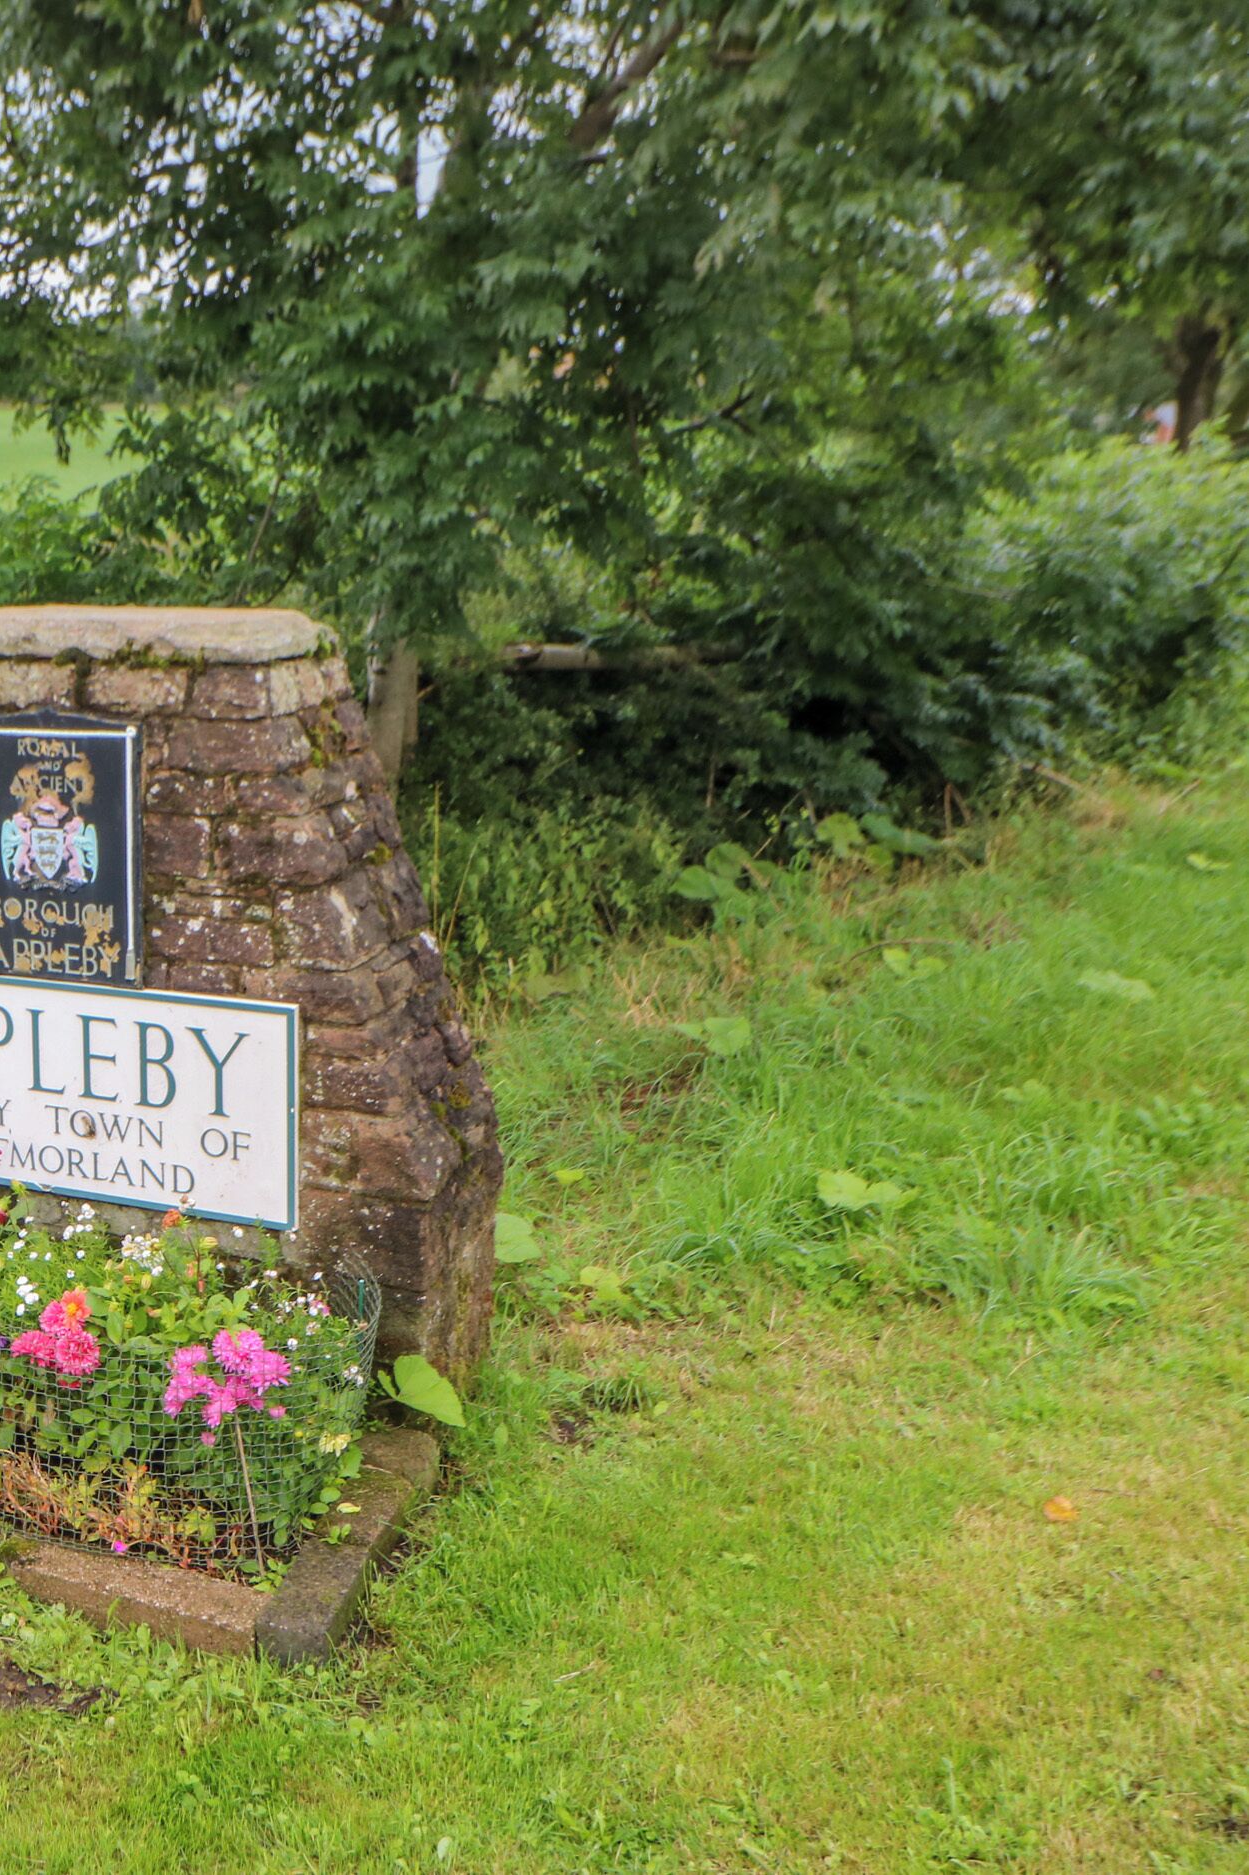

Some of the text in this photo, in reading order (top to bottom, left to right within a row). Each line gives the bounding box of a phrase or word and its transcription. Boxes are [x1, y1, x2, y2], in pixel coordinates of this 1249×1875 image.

[41, 927, 56, 938] OF
[44, 1105, 163, 1149] TOWN
[200, 1128, 251, 1161] OF
